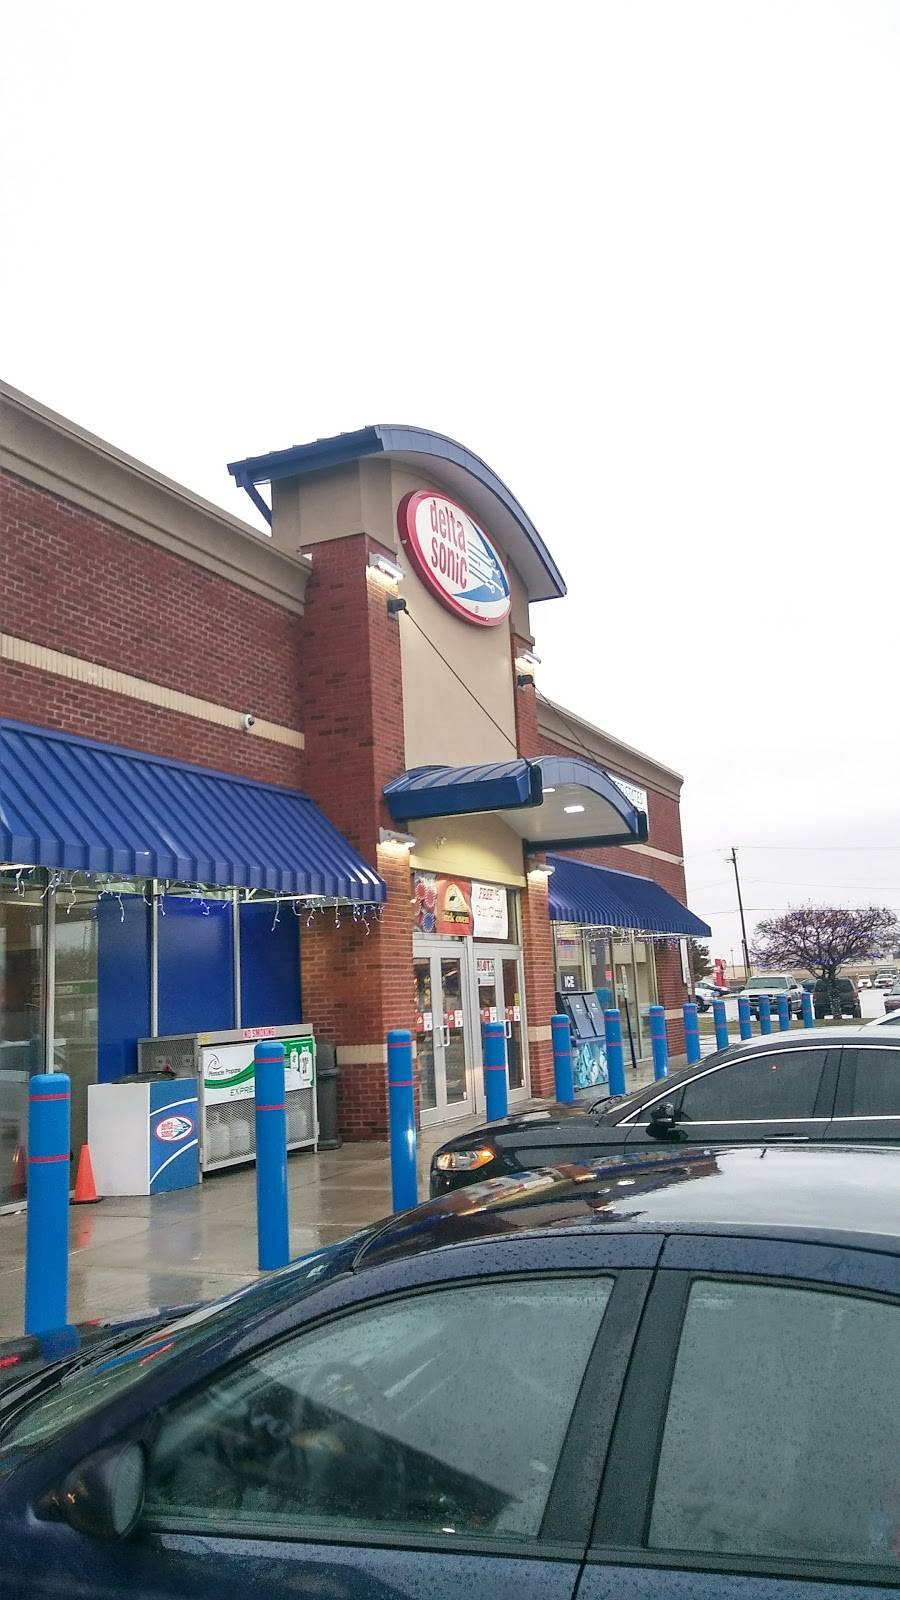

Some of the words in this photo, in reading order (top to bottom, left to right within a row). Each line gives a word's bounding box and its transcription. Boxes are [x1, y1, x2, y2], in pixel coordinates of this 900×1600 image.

[430, 499, 466, 553] delta
[431, 537, 467, 589] sonic
[564, 975, 575, 988] ICE
[244, 1030, 251, 1038] NO
[252, 1027, 275, 1037] SMOKING
[225, 1067, 241, 1075] Propane
[230, 1085, 255, 1097] EXPRE
